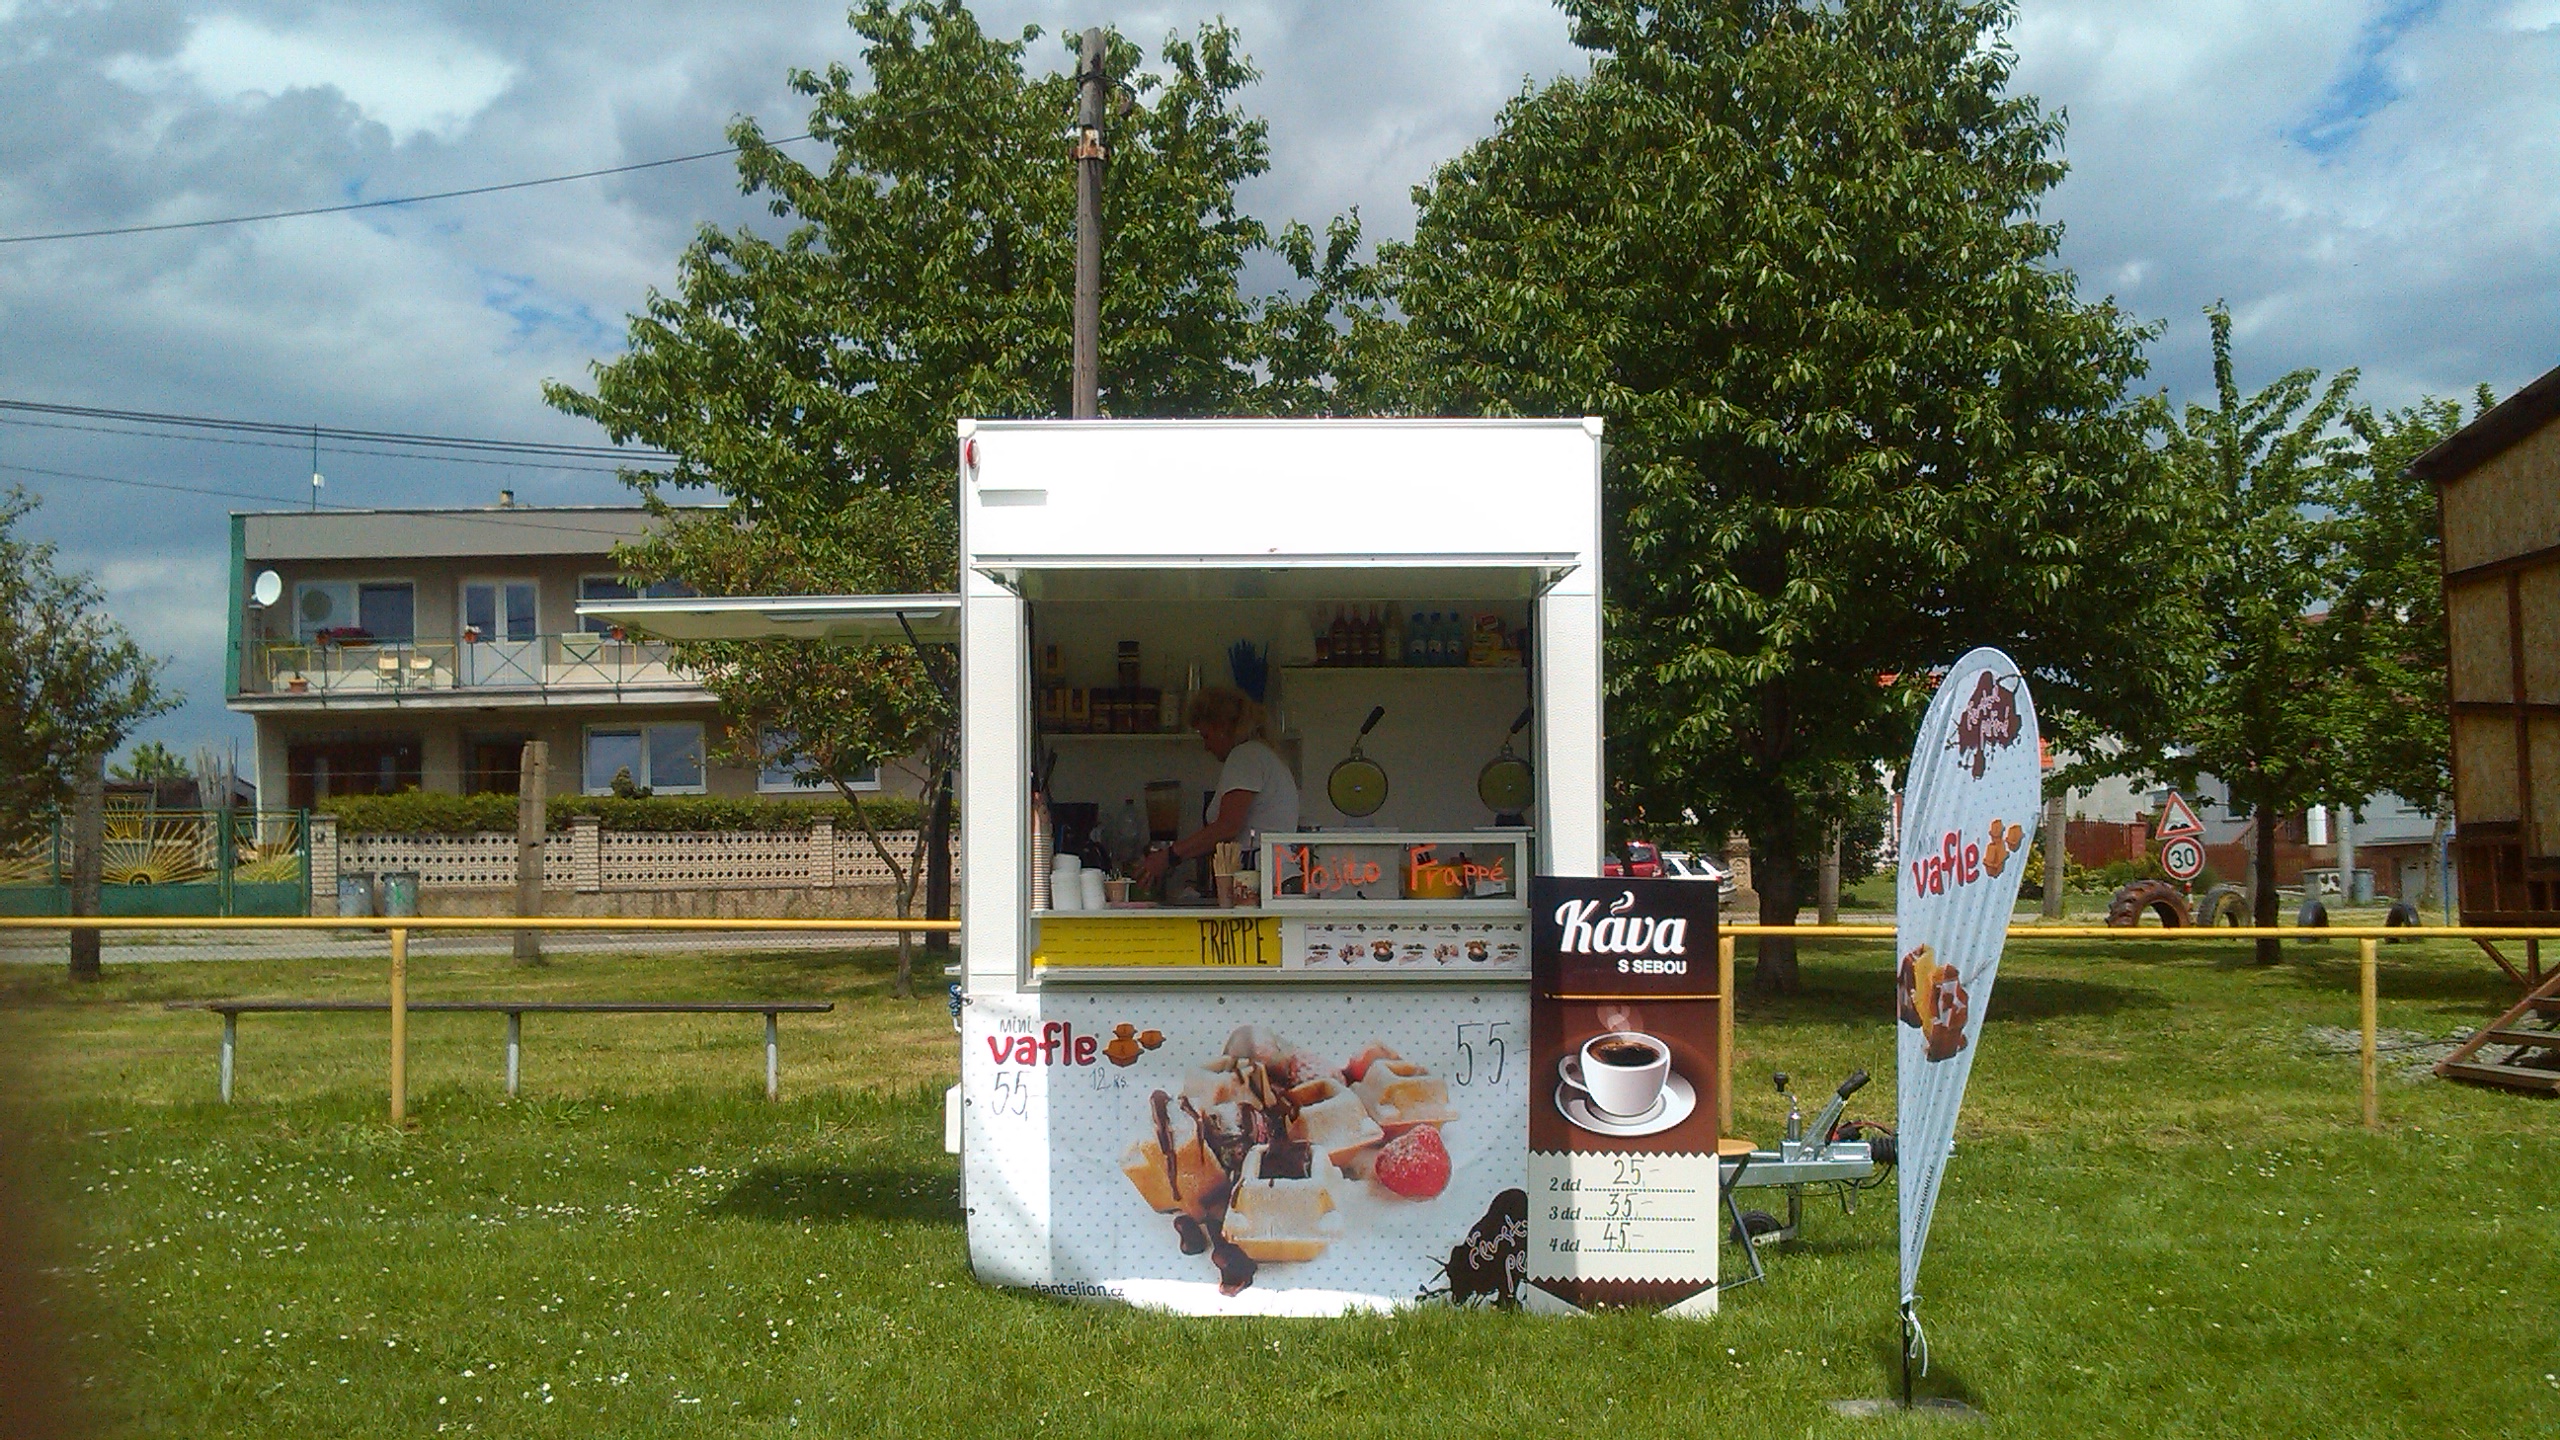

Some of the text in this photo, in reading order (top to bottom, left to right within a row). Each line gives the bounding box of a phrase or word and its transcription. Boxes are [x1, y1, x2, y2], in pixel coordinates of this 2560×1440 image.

[1912, 829, 1980, 899] vafle
[2171, 848, 2195, 868] 30
[1274, 843, 1508, 896] Mojito Frappé
[1554, 890, 1687, 955] Káva
[1618, 959, 1687, 974] S SEBOU
[987, 1021, 1098, 1066] vafle
[1550, 1176, 1559, 1191] 2
[1549, 1206, 1559, 1220] 3
[1549, 1238, 1559, 1252] 4
